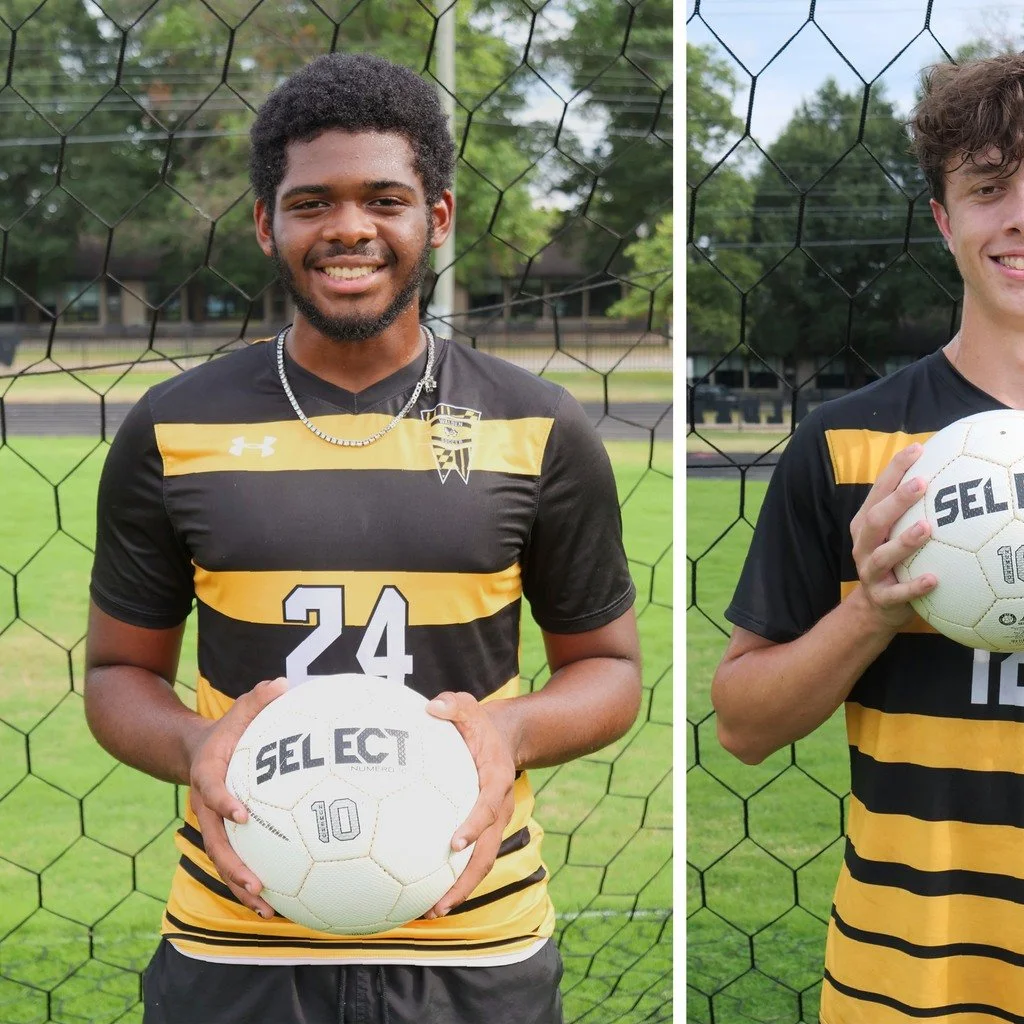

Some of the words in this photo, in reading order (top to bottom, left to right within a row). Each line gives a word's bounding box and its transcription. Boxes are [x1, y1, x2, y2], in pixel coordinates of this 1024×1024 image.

[282, 584, 414, 688] 24
[255, 727, 409, 785] SELECT
[310, 797, 362, 844] 10
